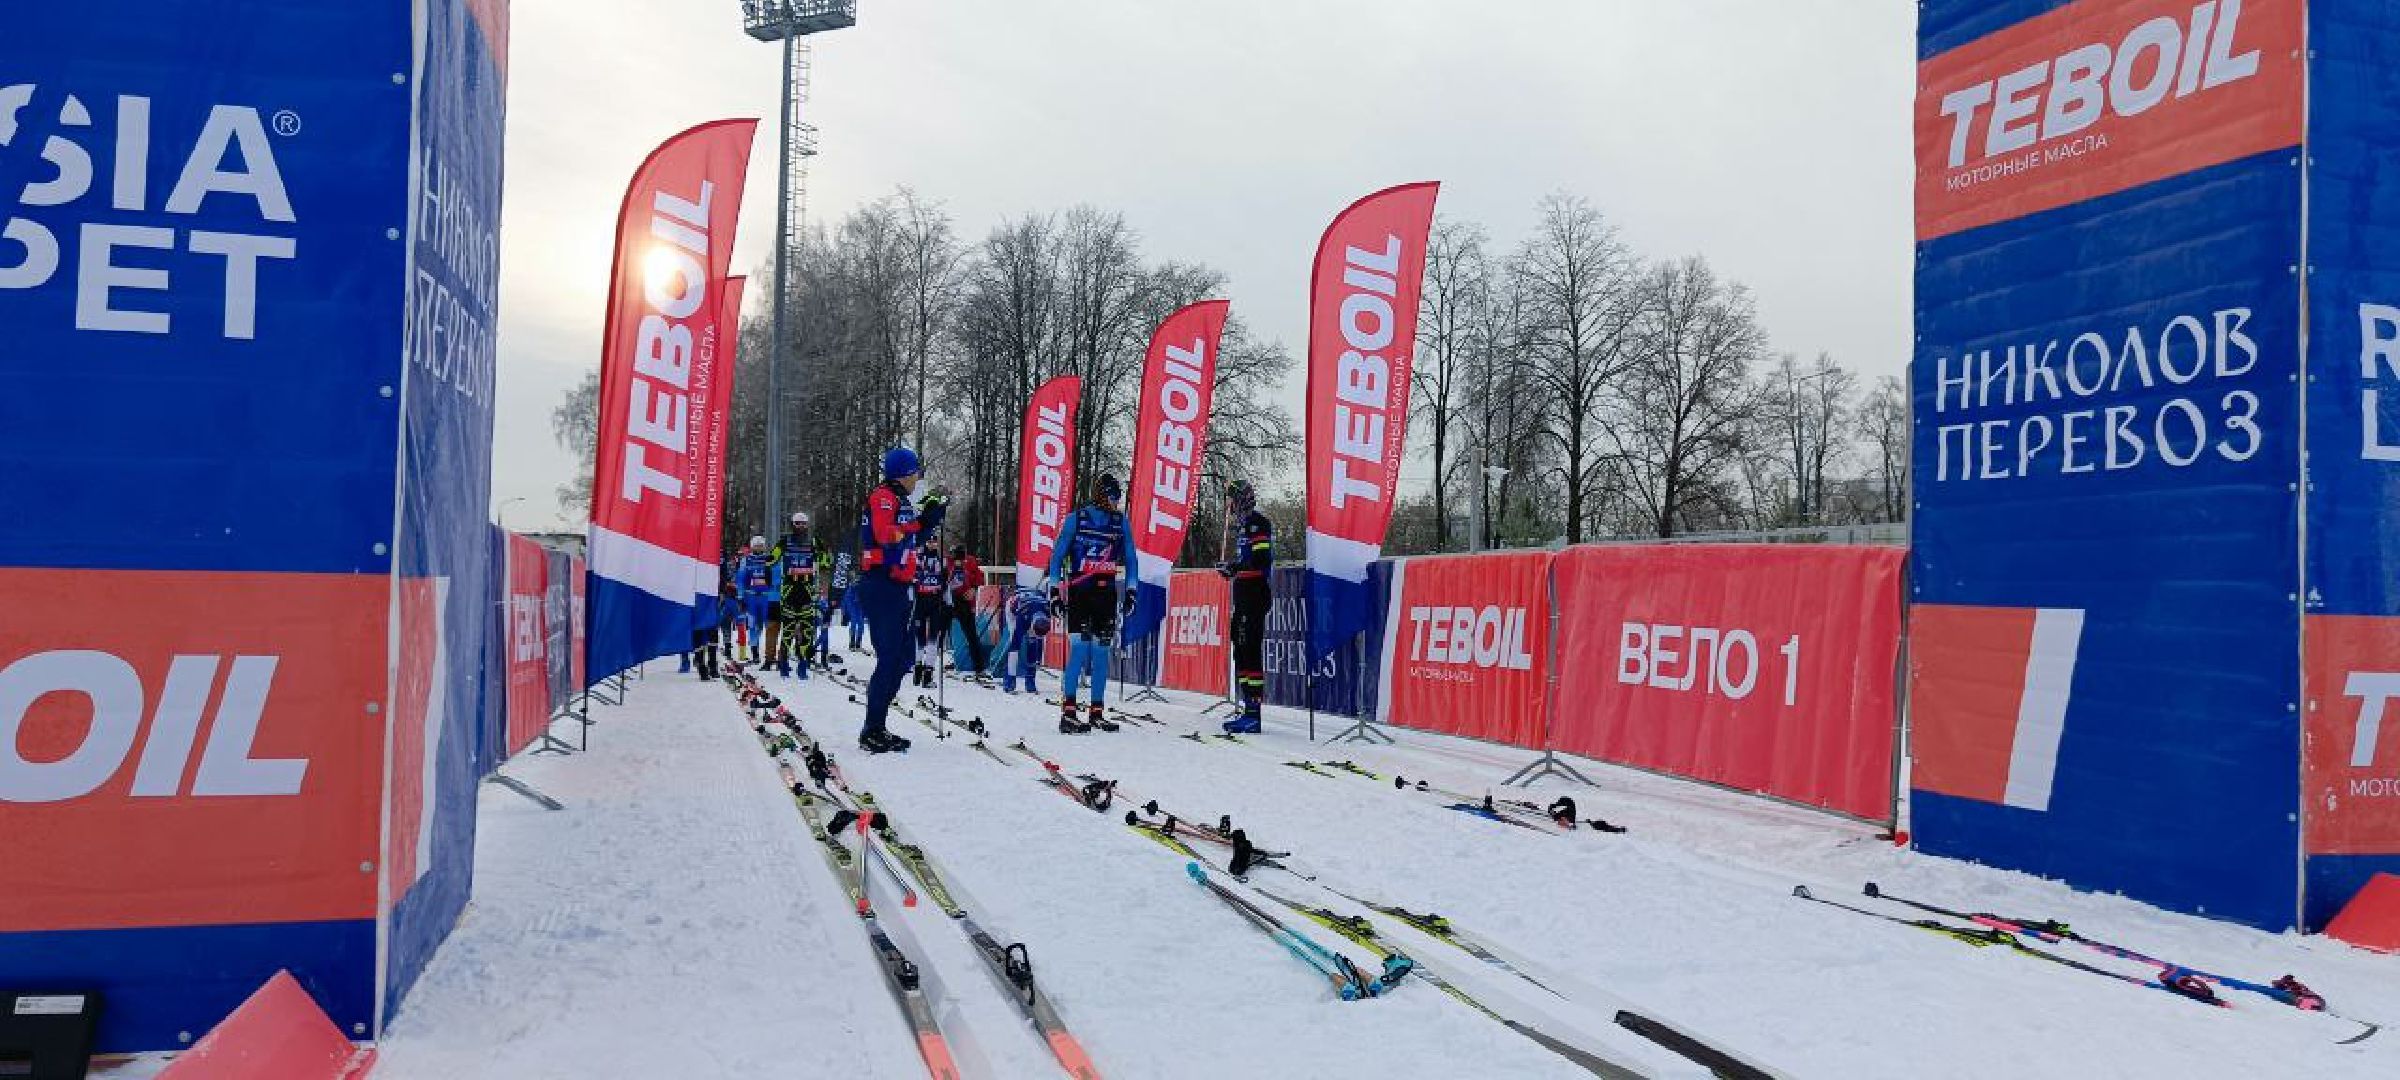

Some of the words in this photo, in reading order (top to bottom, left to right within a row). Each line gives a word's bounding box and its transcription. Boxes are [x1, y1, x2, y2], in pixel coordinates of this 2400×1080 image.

[1940, 0, 2261, 168] TEBOIL
[1947, 151, 2041, 192] МОТОРНЫЕ
[2044, 133, 2109, 166] МАСЛА
[421, 146, 495, 317] НИКОЛО
[414, 267, 491, 408] ПЕРЕВО
[622, 180, 715, 503] TEBOIL
[696, 324, 715, 389] МАСЛА
[1330, 233, 1403, 509] TEBOIL
[1391, 355, 1406, 409] МАСЛА
[1936, 307, 2258, 413] НИКОЛОВ
[687, 392, 706, 499] МОТОРНЫЕ
[1030, 402, 1067, 552] TEBOIL
[1148, 337, 1206, 535] TEBOIL
[1386, 413, 1402, 503] ОТОРНЫЕ
[1936, 389, 2263, 482] ПЕРЕВОЗ
[1410, 605, 1532, 670] TEBOIL
[1618, 621, 1759, 700] ВЕЛО
[1780, 634, 1799, 706] 1
[0, 649, 309, 803] OIL
